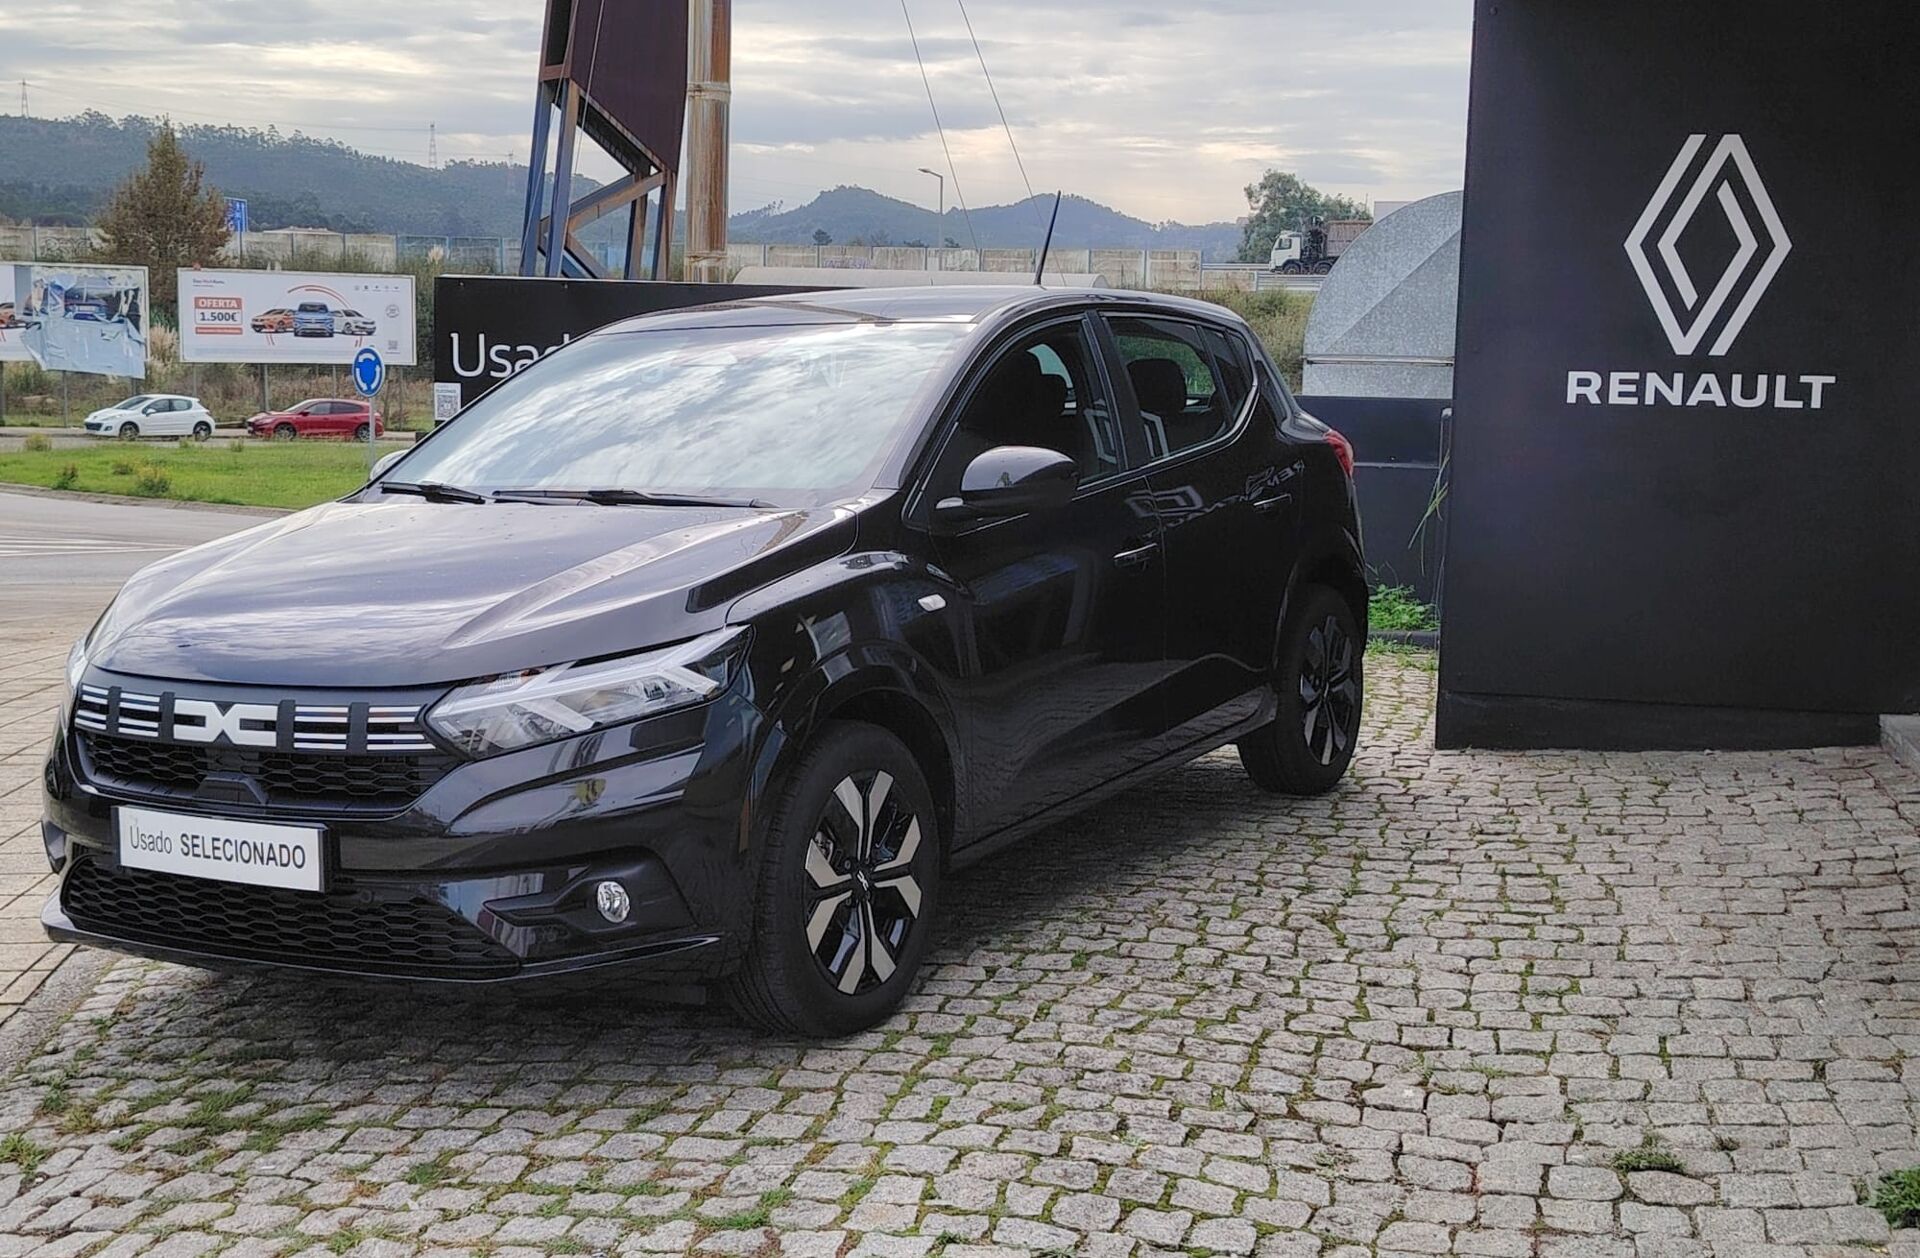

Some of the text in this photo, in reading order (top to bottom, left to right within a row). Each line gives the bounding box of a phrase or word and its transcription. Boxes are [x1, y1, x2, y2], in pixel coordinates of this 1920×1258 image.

[199, 299, 238, 308] OFERTA
[200, 311, 238, 322] 1.500€
[450, 333, 570, 378] Usa
[1566, 370, 1837, 409] RENAULT
[130, 825, 306, 870] Usado SELECIONADO
